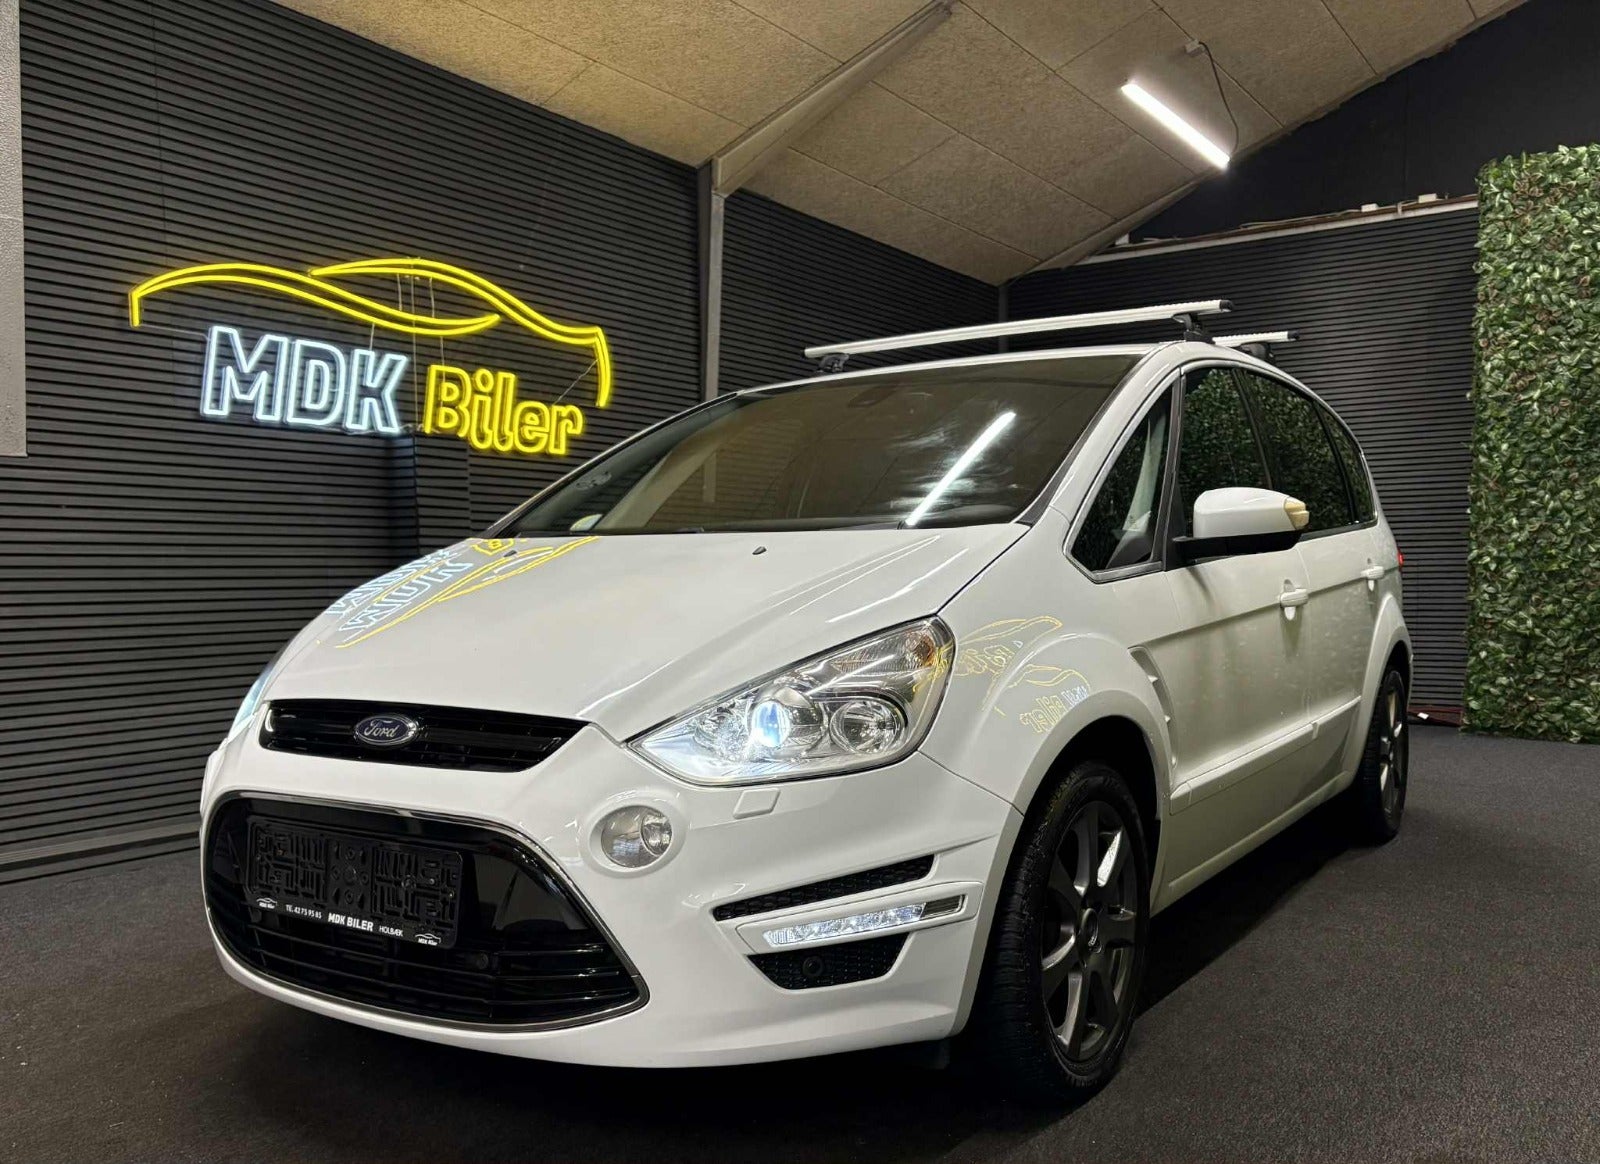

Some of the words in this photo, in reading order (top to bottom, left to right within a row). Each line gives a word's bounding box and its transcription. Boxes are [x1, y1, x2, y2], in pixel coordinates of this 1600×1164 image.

[201, 324, 408, 434] MDK
[423, 363, 584, 456] Biler
[363, 720, 400, 737] Ford
[327, 912, 346, 925] MDK
[346, 916, 374, 932] BILER
[379, 925, 403, 936] HOLBÆK
